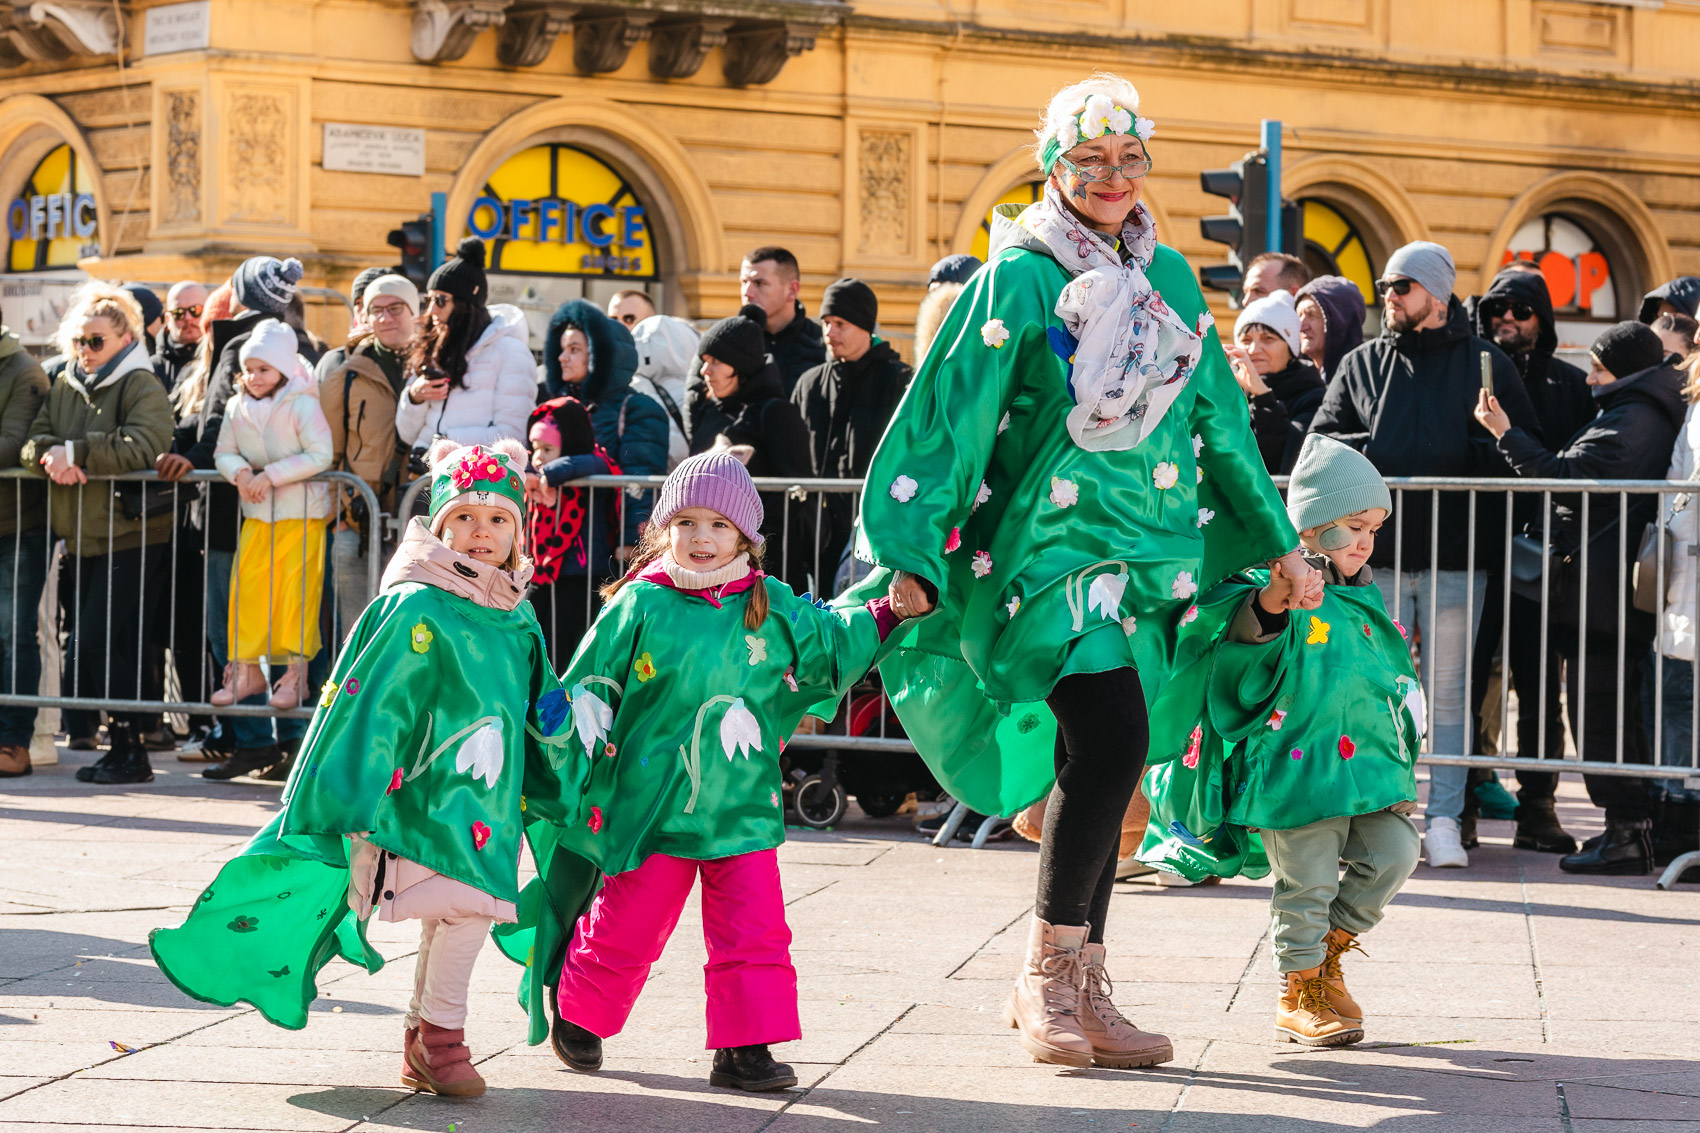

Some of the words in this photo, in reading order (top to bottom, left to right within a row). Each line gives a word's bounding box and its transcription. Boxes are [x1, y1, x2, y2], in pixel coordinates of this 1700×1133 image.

[7, 193, 97, 241] OFFIC
[468, 197, 644, 248] OFFICE
[581, 254, 642, 271] SHOES
